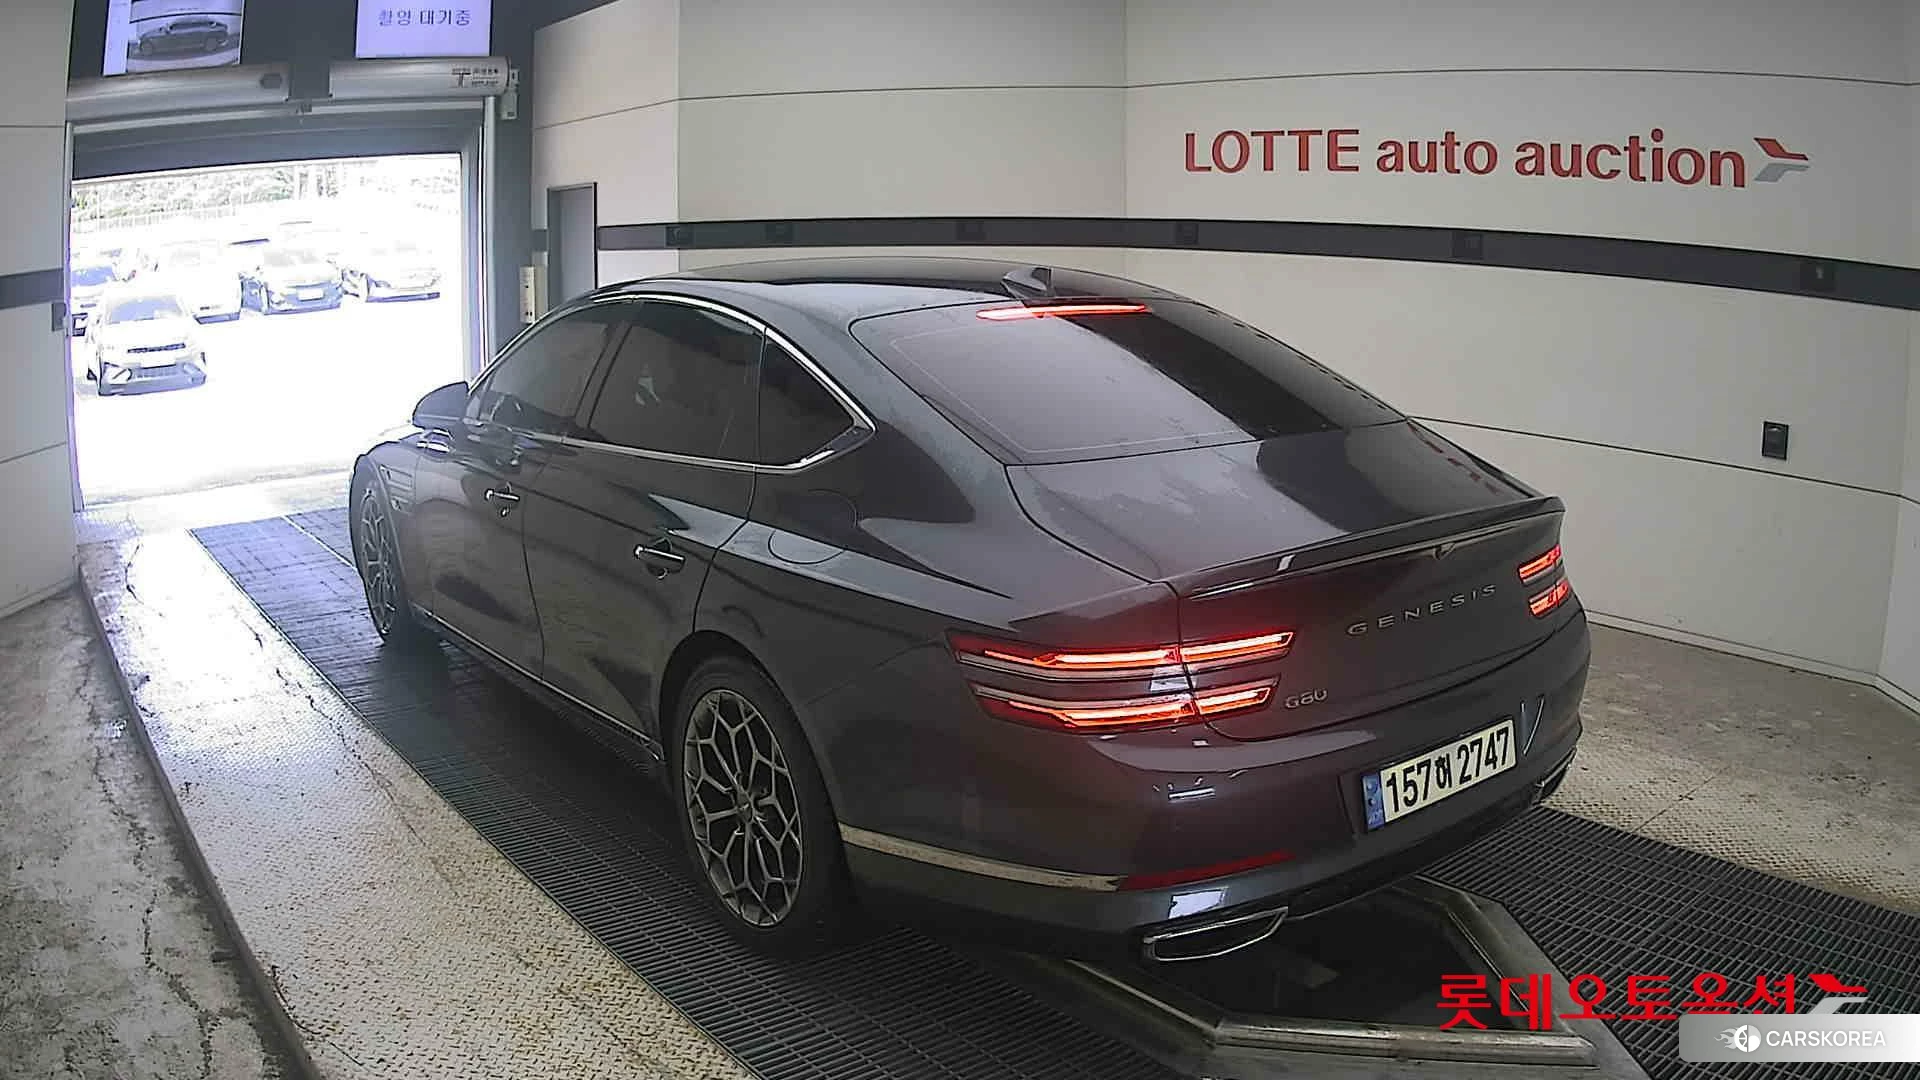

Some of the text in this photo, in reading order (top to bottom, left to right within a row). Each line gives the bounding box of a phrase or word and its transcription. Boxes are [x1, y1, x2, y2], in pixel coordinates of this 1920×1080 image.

[420, 9, 470, 26] 대기중
[1185, 128, 1745, 189] LOTTE auto auction
[1347, 583, 1496, 636] GENESIS
[1386, 726, 1510, 813] 157허 2747
